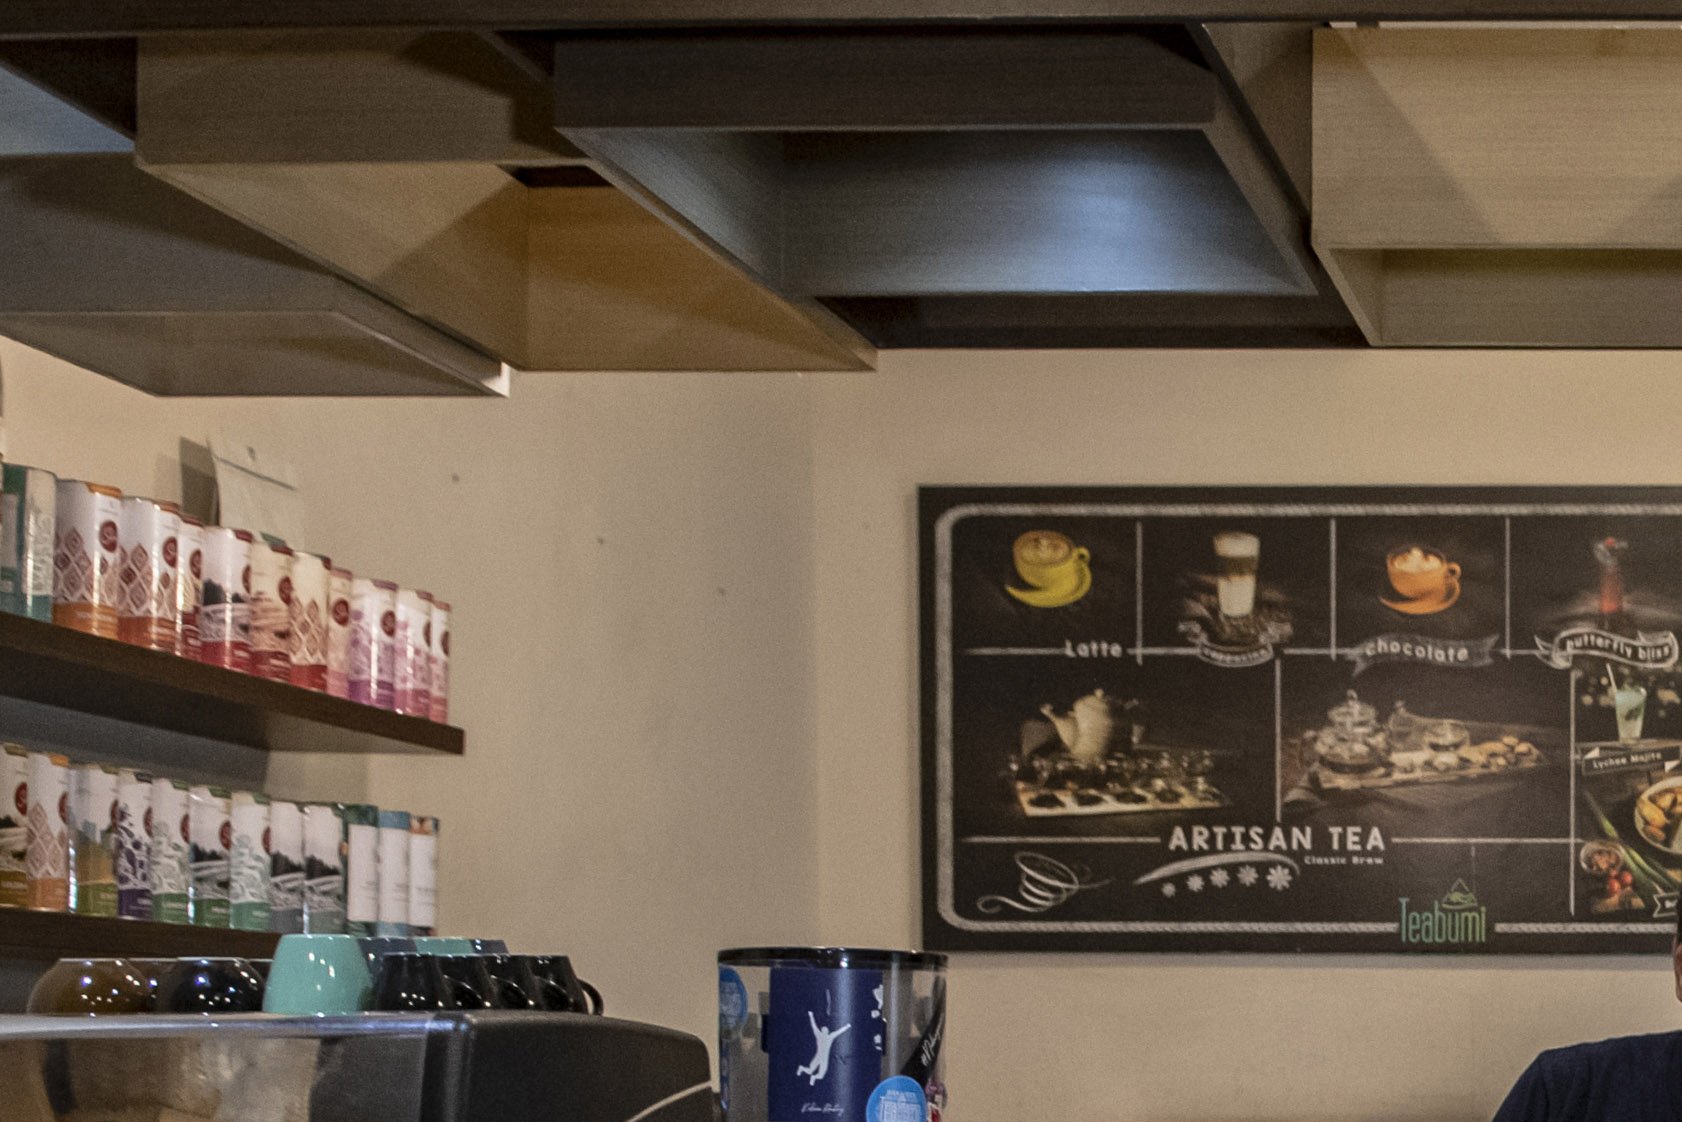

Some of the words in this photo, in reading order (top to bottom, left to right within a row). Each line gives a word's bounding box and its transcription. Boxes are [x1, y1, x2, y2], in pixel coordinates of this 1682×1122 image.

[1063, 639, 1123, 659] Latte
[1365, 638, 1469, 662] chocolate
[1168, 826, 1313, 851] ARTISAN
[1328, 826, 1385, 851] TEA
[1399, 897, 1486, 944] Teabumi
